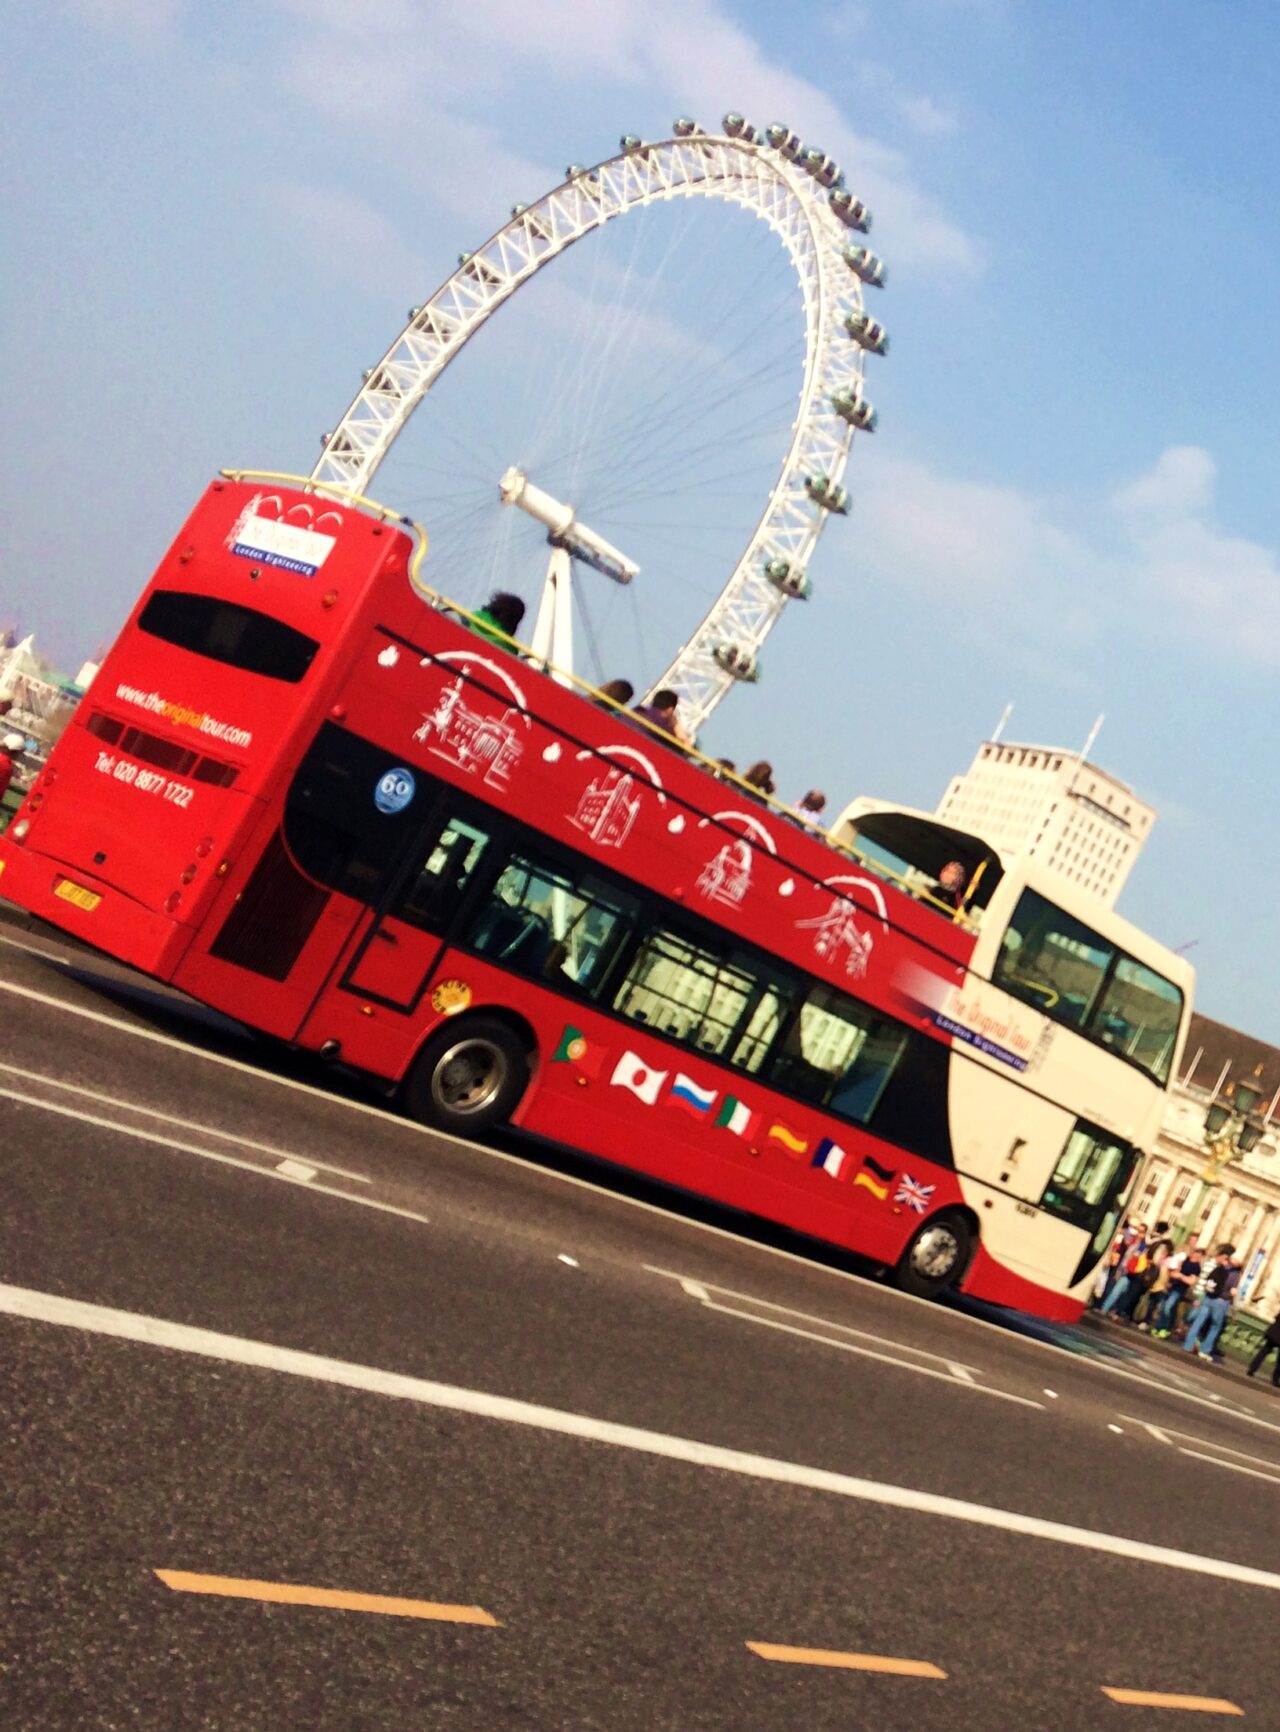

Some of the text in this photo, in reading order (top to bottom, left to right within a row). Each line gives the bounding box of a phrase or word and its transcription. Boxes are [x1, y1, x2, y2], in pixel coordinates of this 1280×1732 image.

[115, 682, 253, 749] www.theoriginaltour.com
[94, 751, 195, 809] Tel: 020 8877 1722
[380, 773, 410, 796] 60
